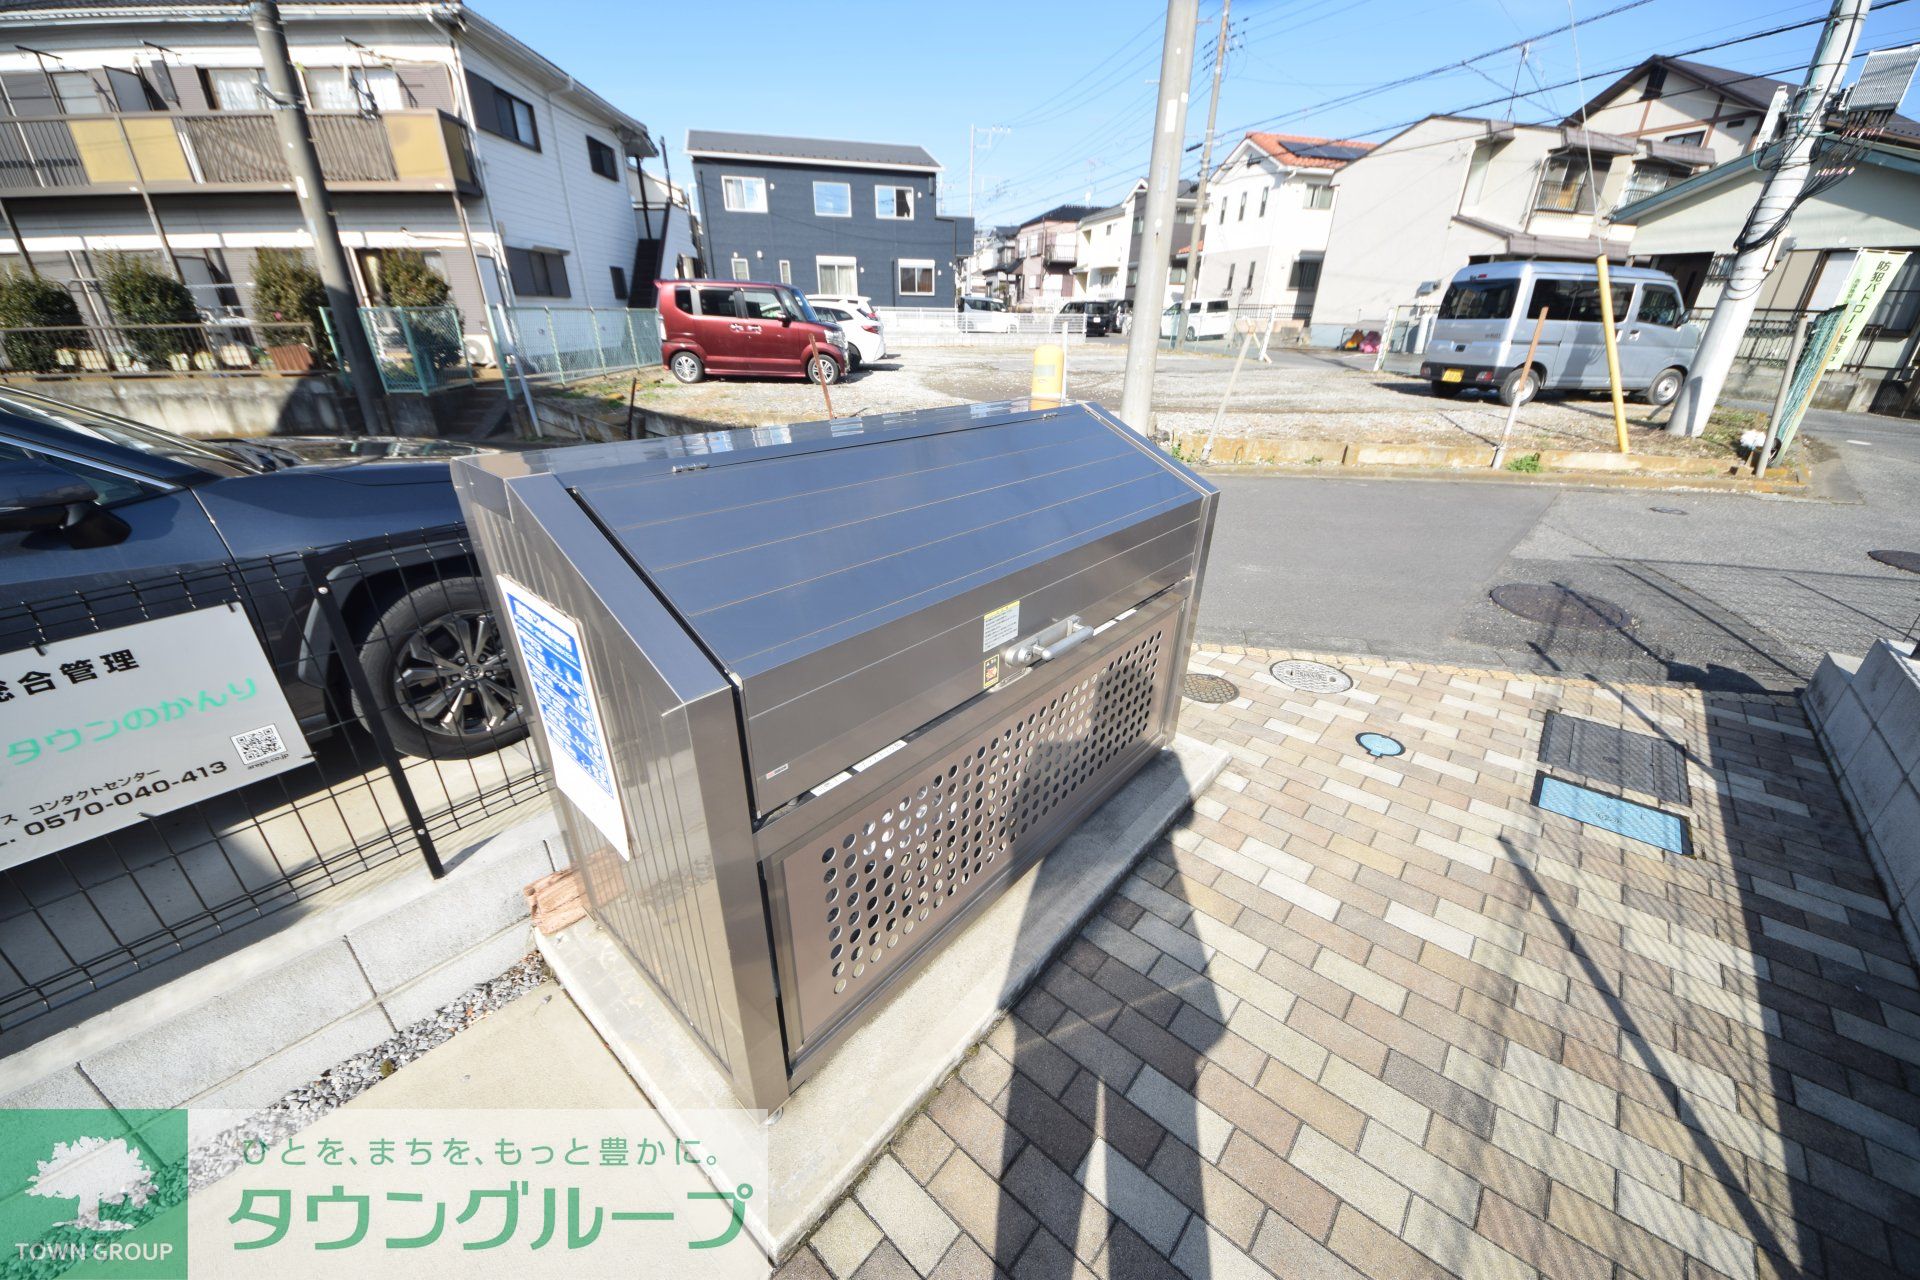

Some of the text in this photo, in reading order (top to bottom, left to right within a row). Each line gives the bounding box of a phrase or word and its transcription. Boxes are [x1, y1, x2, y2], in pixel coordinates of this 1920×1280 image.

[6, 677, 258, 766] タウンのかんり
[23, 760, 229, 837] 0570-040-413
[29, 769, 161, 816] コンタクトセンター
